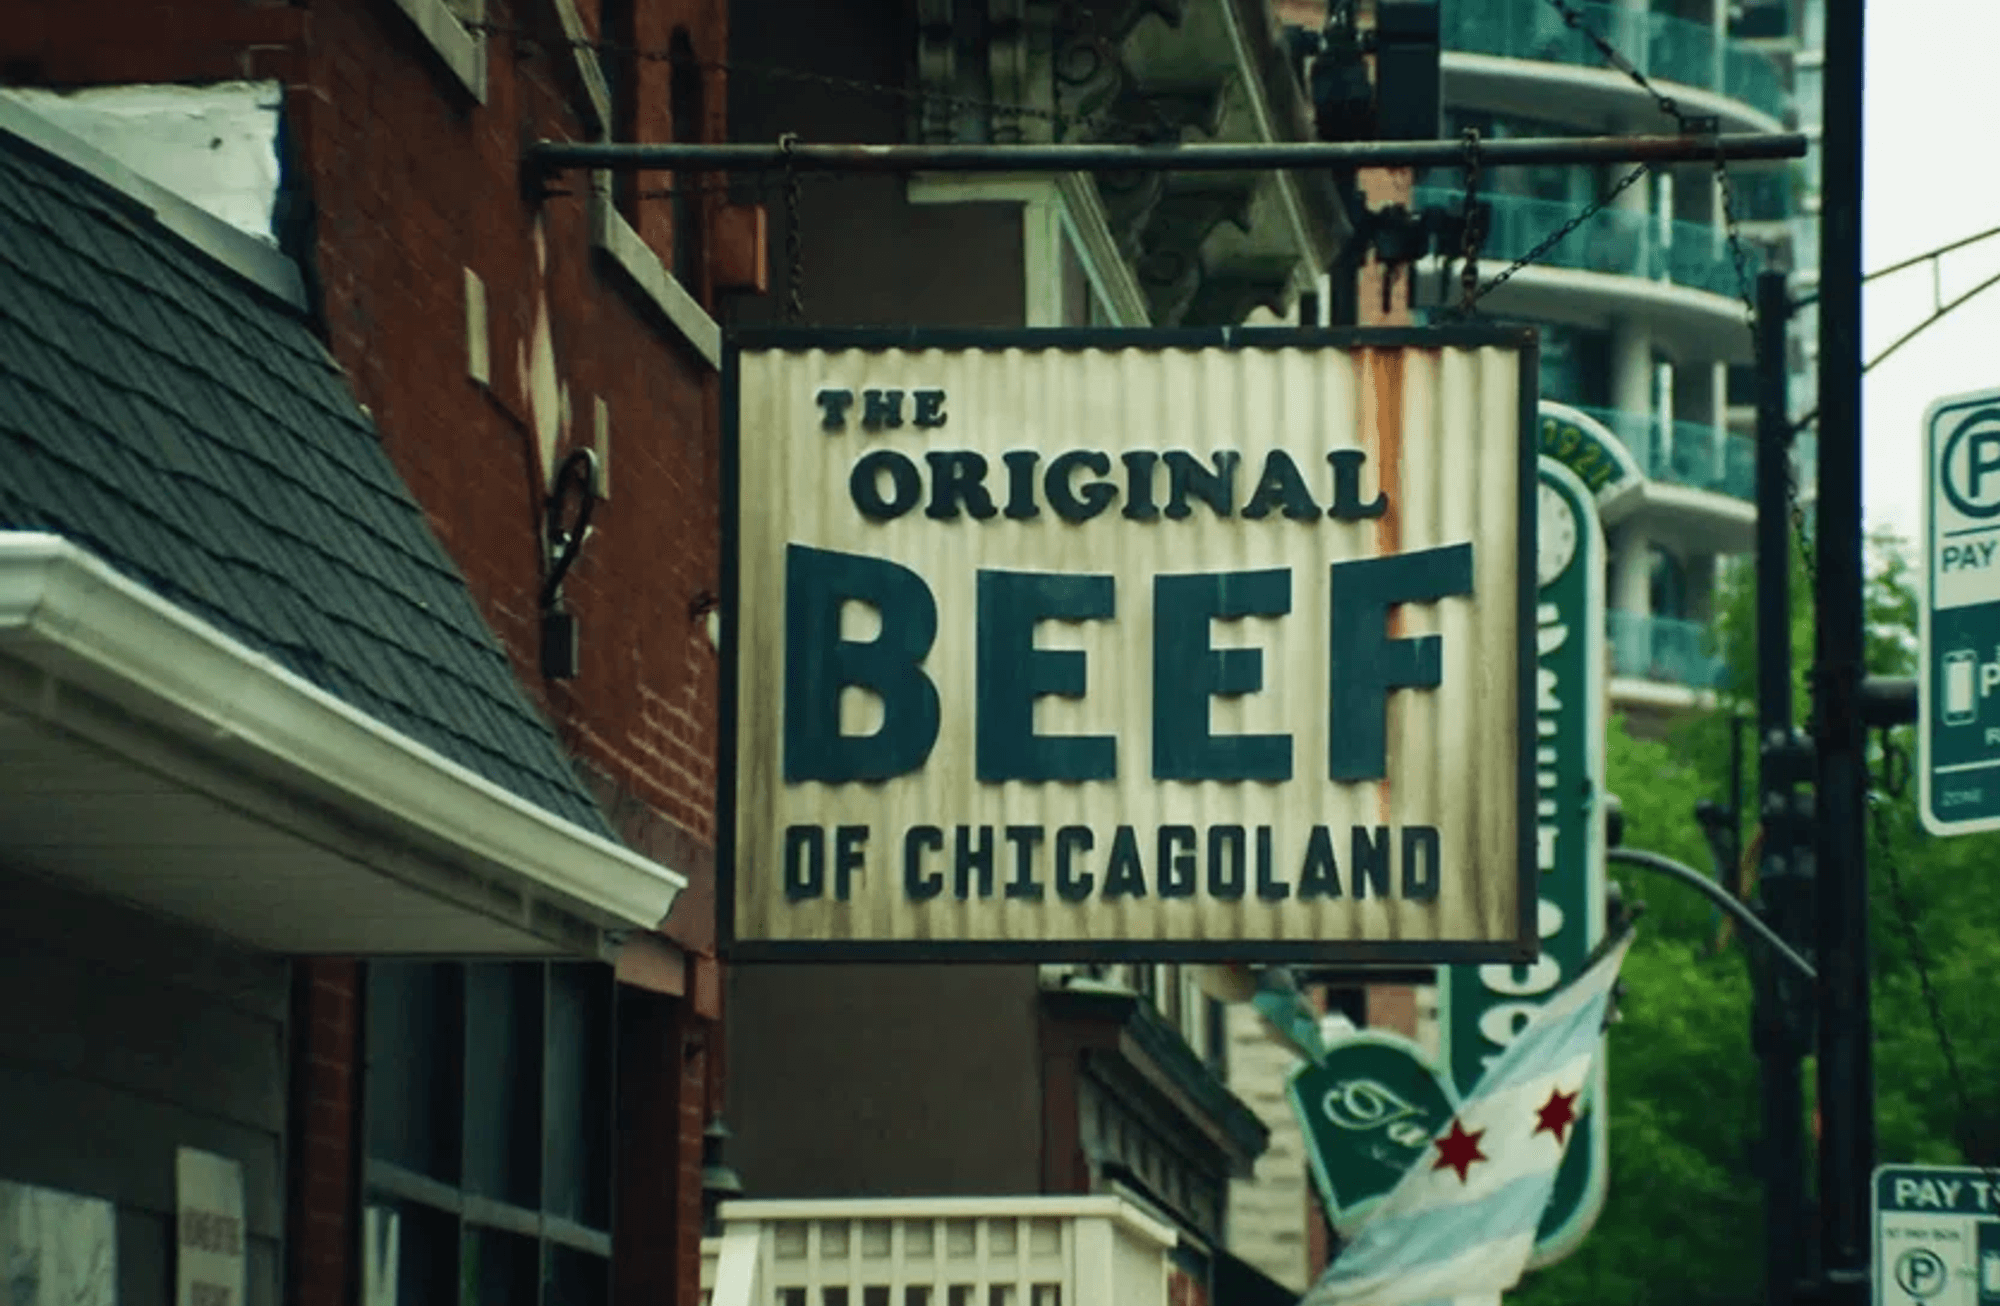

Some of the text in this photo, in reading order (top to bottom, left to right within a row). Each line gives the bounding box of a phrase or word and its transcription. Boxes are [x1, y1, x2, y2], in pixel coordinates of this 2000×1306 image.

[816, 389, 948, 430] THE
[849, 449, 1388, 522] ORIGINAL
[1941, 540, 1998, 573] PAY
[783, 542, 1473, 783] BEEF
[784, 825, 1441, 902] OF CHICAGOLAND
[1894, 1178, 1961, 1208] PAY
[1910, 1258, 1937, 1289] P
